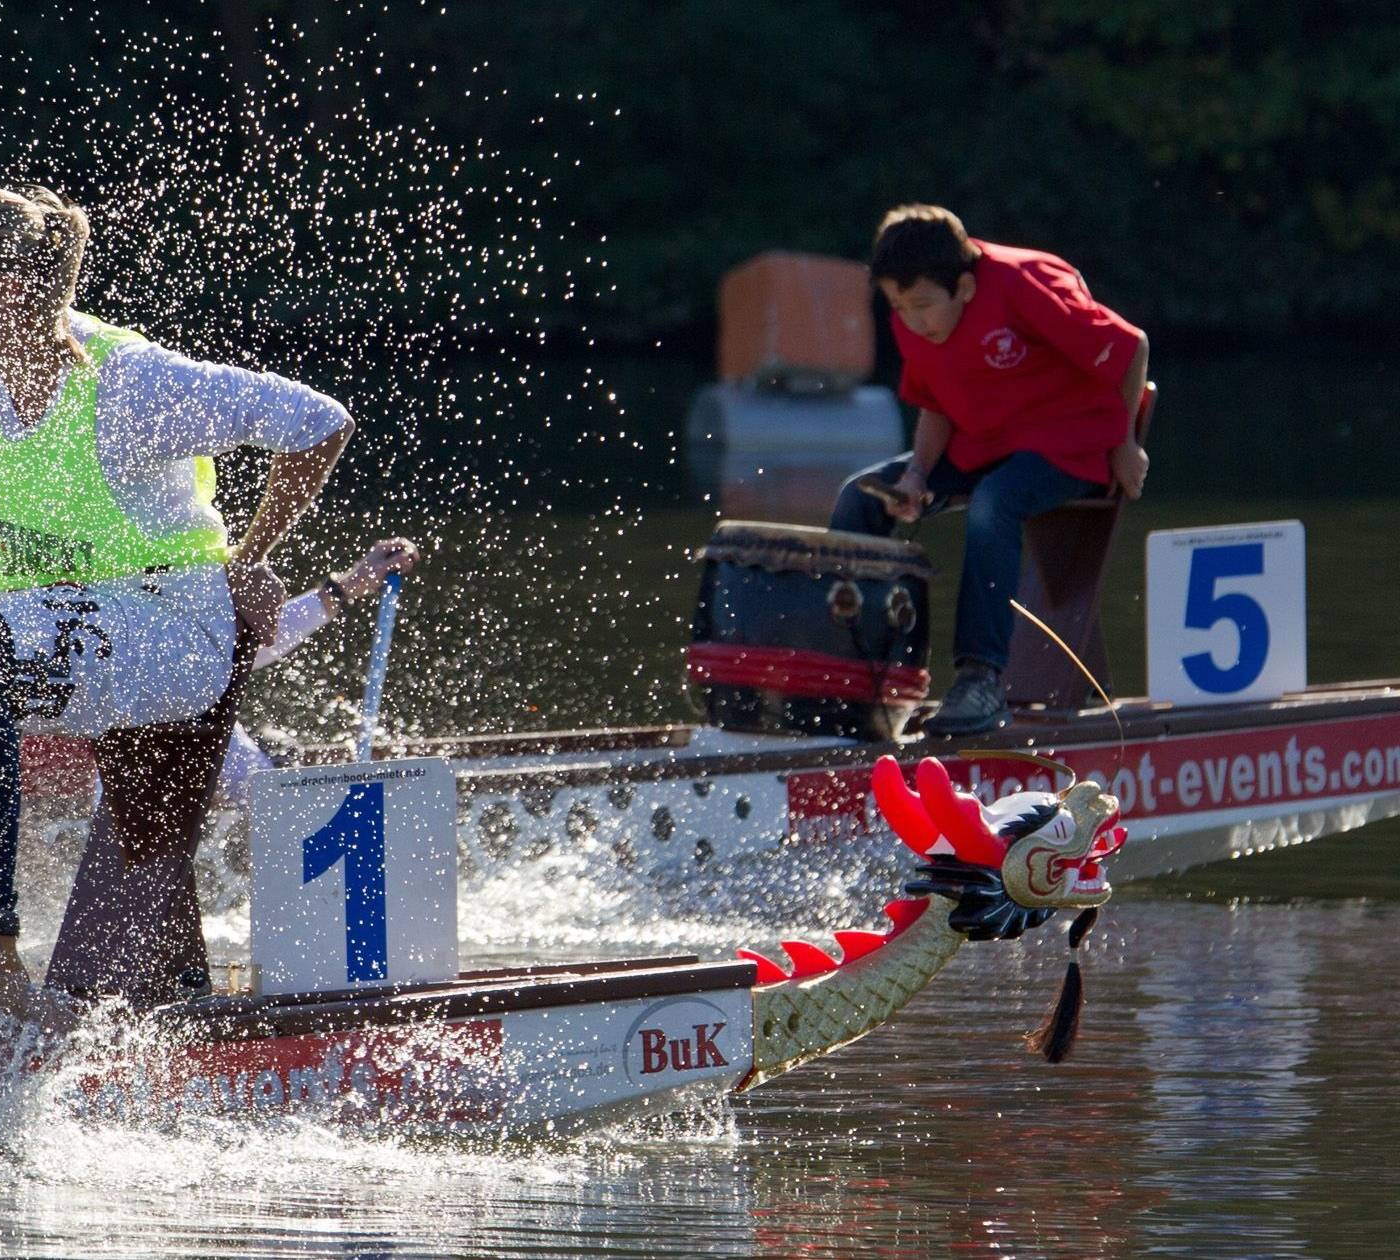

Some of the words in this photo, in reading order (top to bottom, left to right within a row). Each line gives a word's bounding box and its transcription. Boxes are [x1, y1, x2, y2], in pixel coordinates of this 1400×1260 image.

[1181, 542, 1270, 695] 5
[303, 782, 387, 983] 1
[638, 1022, 729, 1074] BuK
